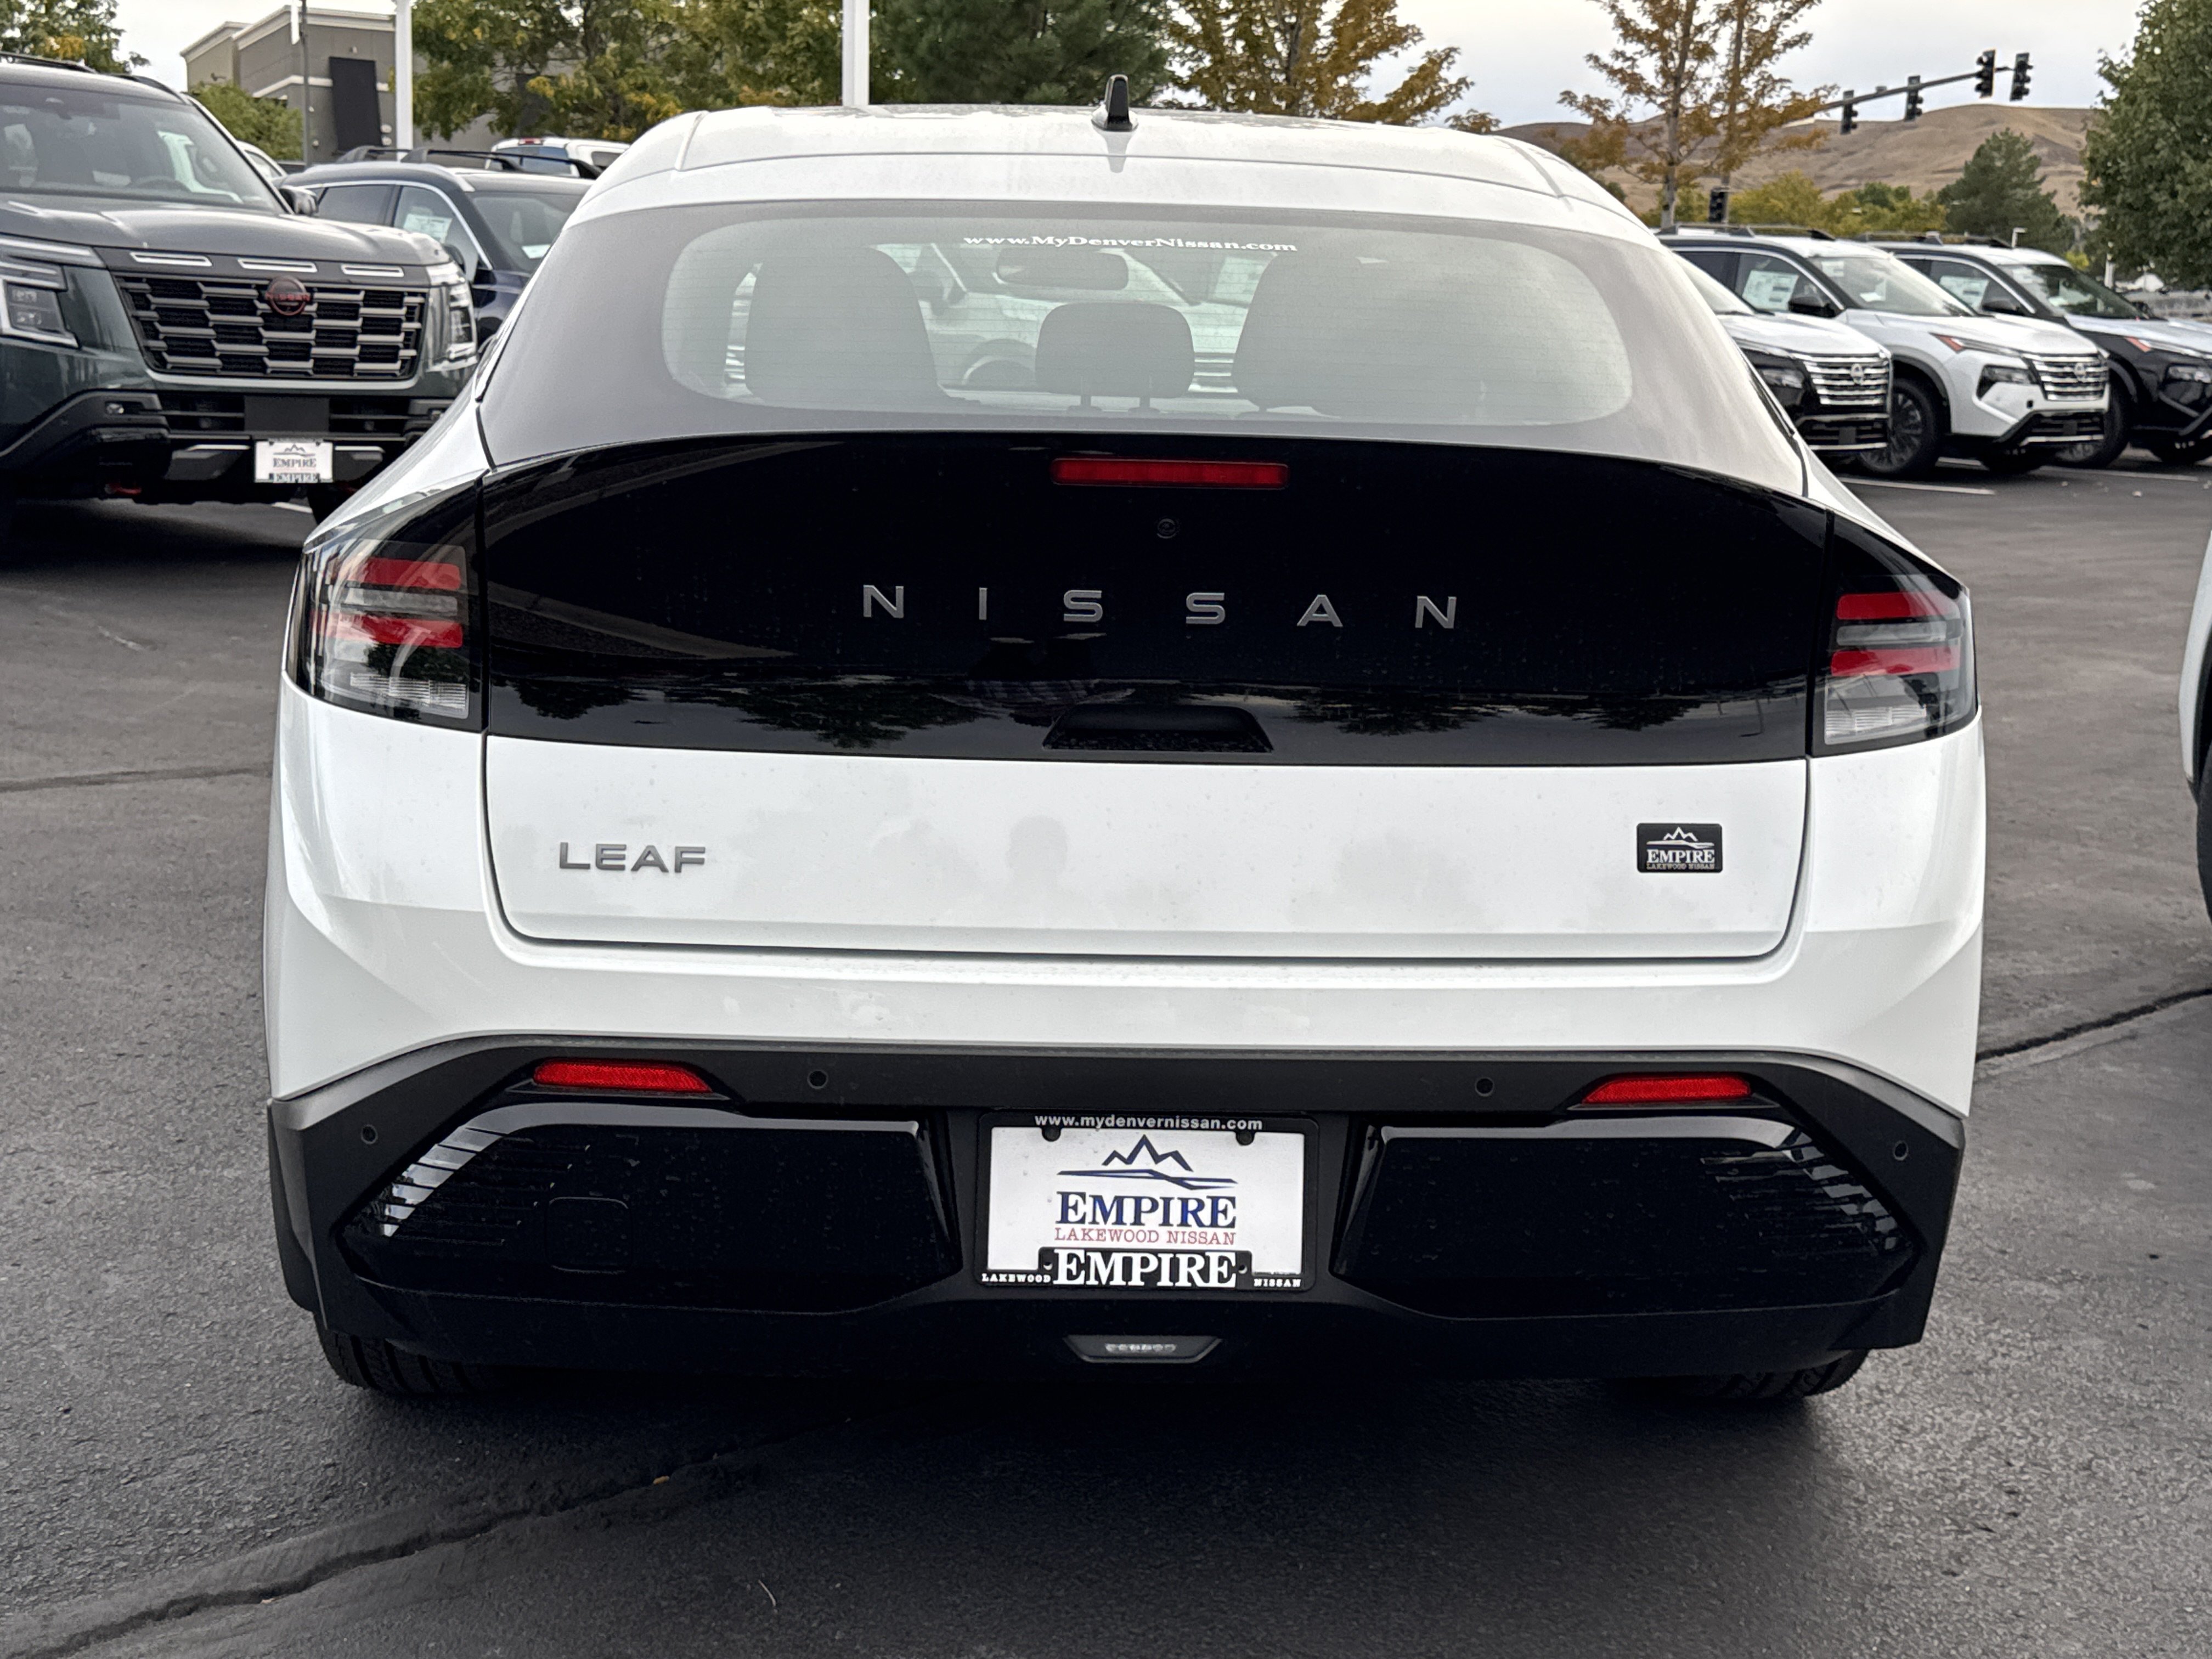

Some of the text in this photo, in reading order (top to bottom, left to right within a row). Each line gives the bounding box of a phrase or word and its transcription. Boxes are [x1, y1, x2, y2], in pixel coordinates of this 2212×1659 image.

[963, 235, 1297, 252] www.MyDenverNissan.com
[273, 458, 317, 468] EMPIRE
[862, 585, 1458, 629] NISSAN
[559, 842, 706, 873] LEAF
[1646, 849, 1715, 864] EMPIRE
[1034, 1114, 1263, 1131] www.mydenvernissan.com
[1055, 1190, 1237, 1229] EMPIRE
[1054, 1227, 1237, 1245] LAKEWOOD NISSAN
[1052, 1248, 1237, 1288] EMPIRE
[981, 1273, 1051, 1284] LAKEWOOD
[1253, 1278, 1302, 1288] NISSAN
